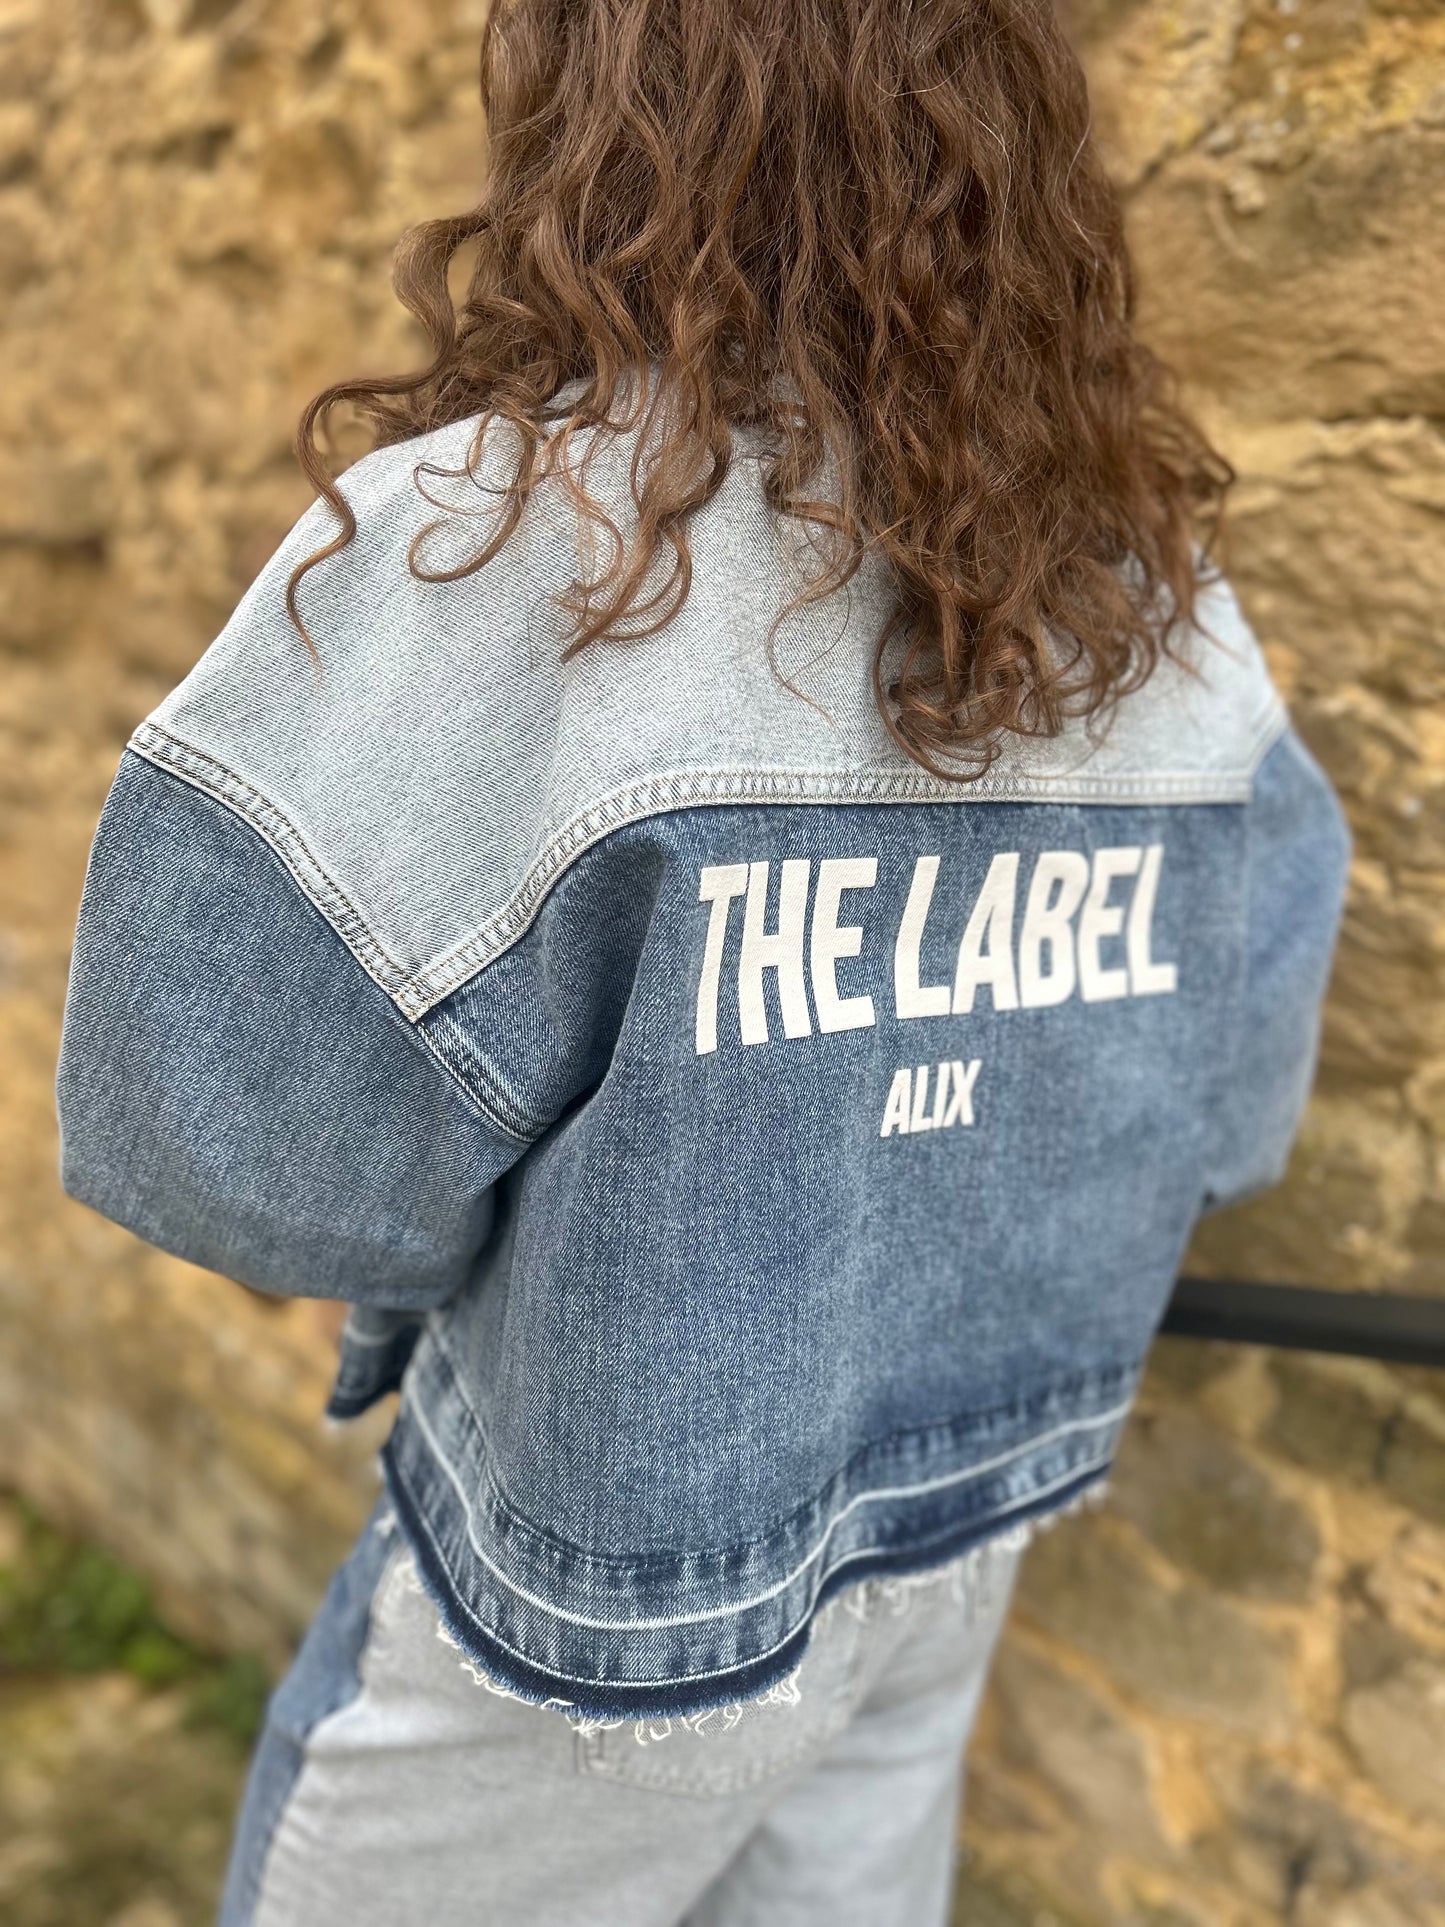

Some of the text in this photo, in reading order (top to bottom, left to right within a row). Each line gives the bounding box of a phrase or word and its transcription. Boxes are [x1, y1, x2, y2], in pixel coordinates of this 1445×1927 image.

[695, 844, 1178, 1056] THE LABEL
[880, 1059, 983, 1138] ALIX
